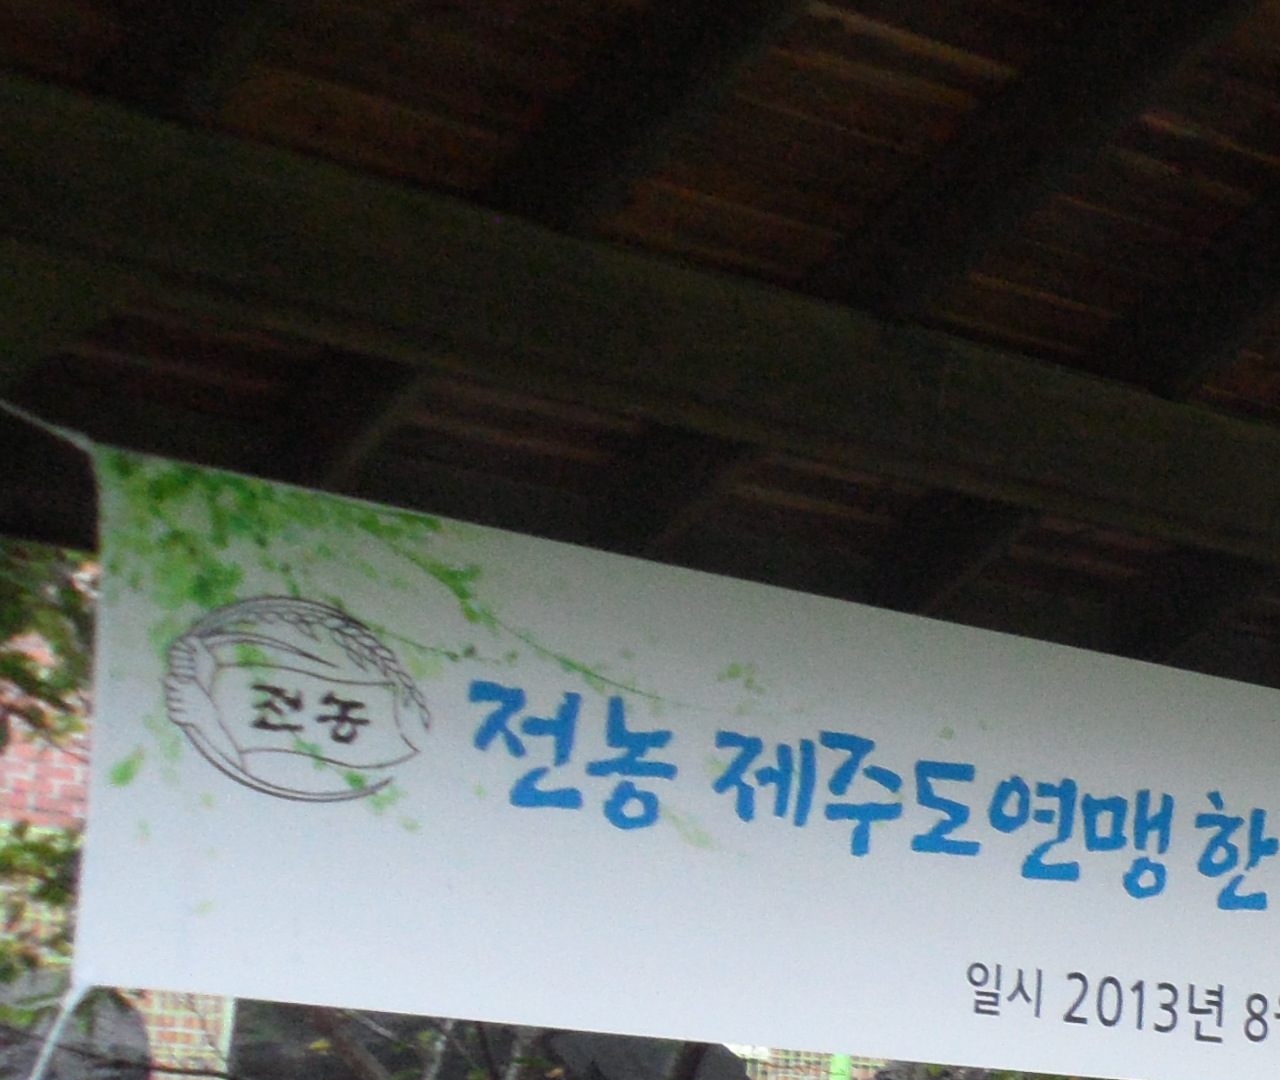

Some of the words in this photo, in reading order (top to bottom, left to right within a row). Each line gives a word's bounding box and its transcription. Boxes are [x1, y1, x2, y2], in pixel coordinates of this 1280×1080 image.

[250, 682, 371, 746] 전농
[467, 679, 679, 831] 전농
[965, 961, 1044, 1020] 일시
[1062, 970, 1226, 1045] 2013년
